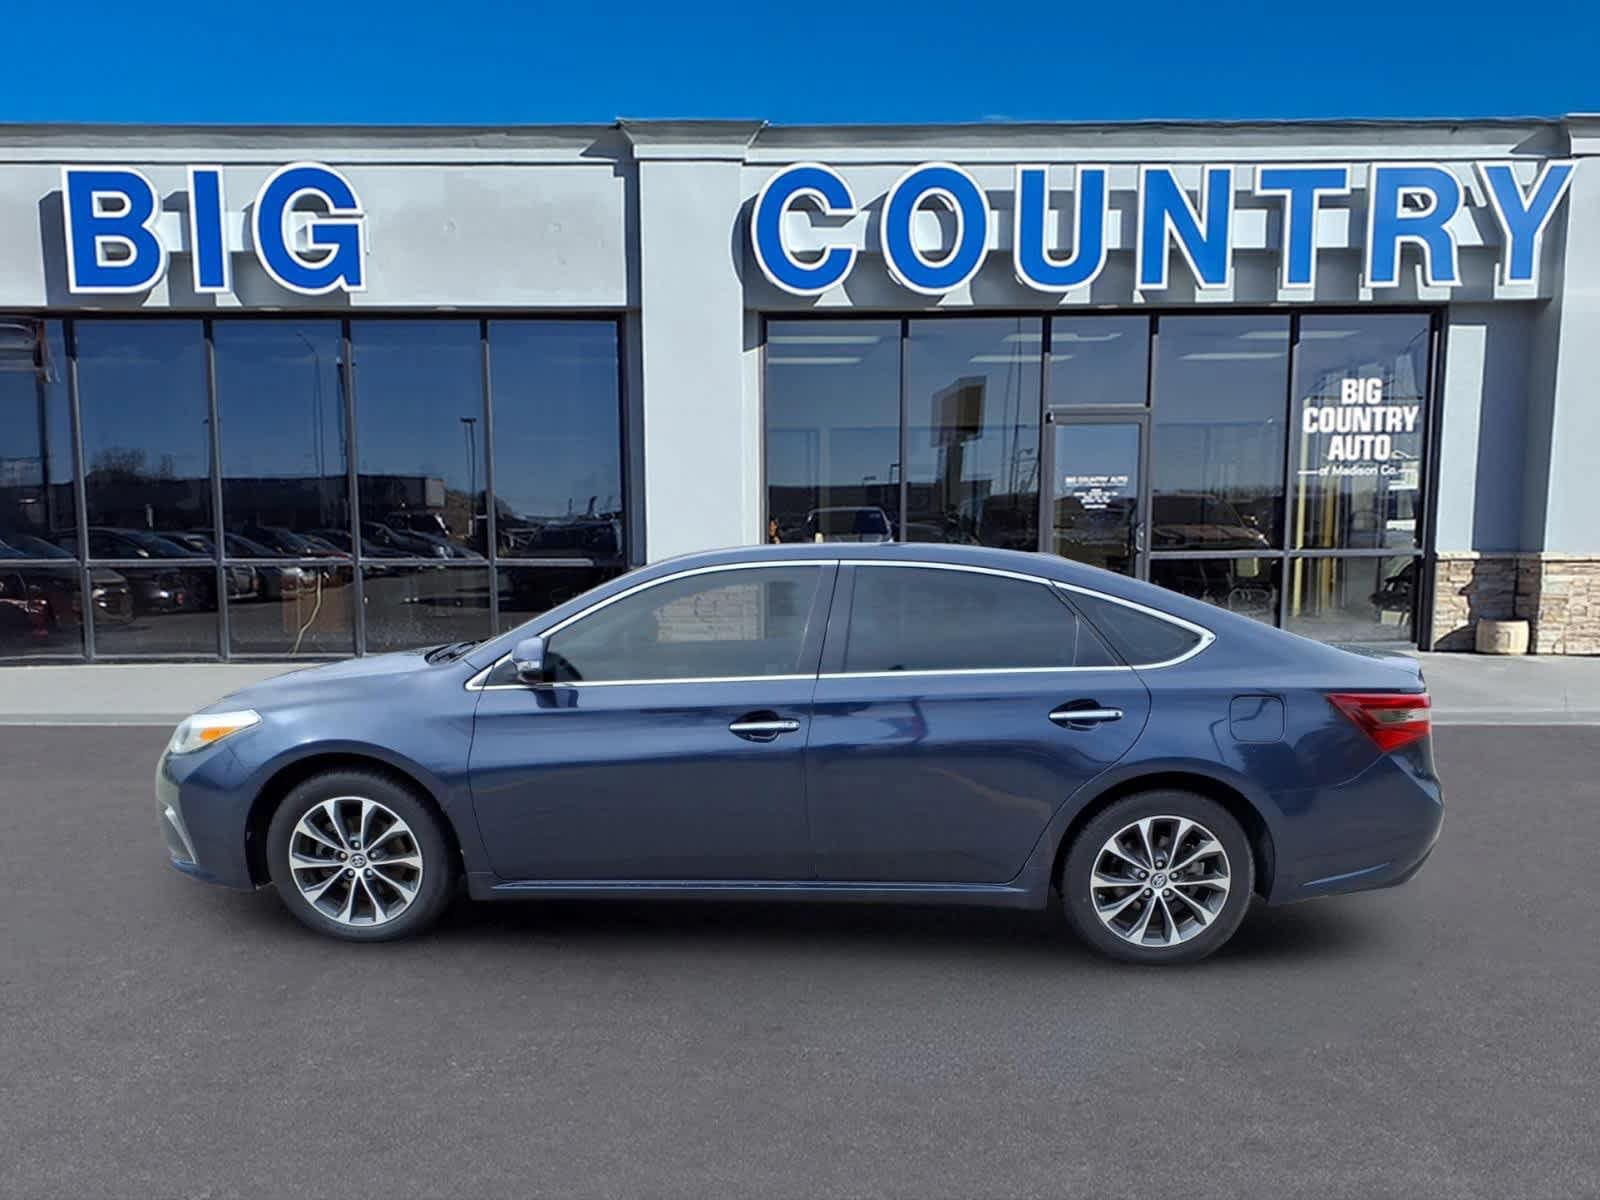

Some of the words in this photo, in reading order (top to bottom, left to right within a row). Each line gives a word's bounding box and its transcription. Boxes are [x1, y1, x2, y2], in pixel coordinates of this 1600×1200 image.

[61, 161, 366, 295] BIG
[751, 161, 1577, 296] COUNTRY
[1341, 378, 1383, 405] BIG
[1303, 405, 1420, 433] COUNTRY
[1327, 434, 1392, 461] AUTO
